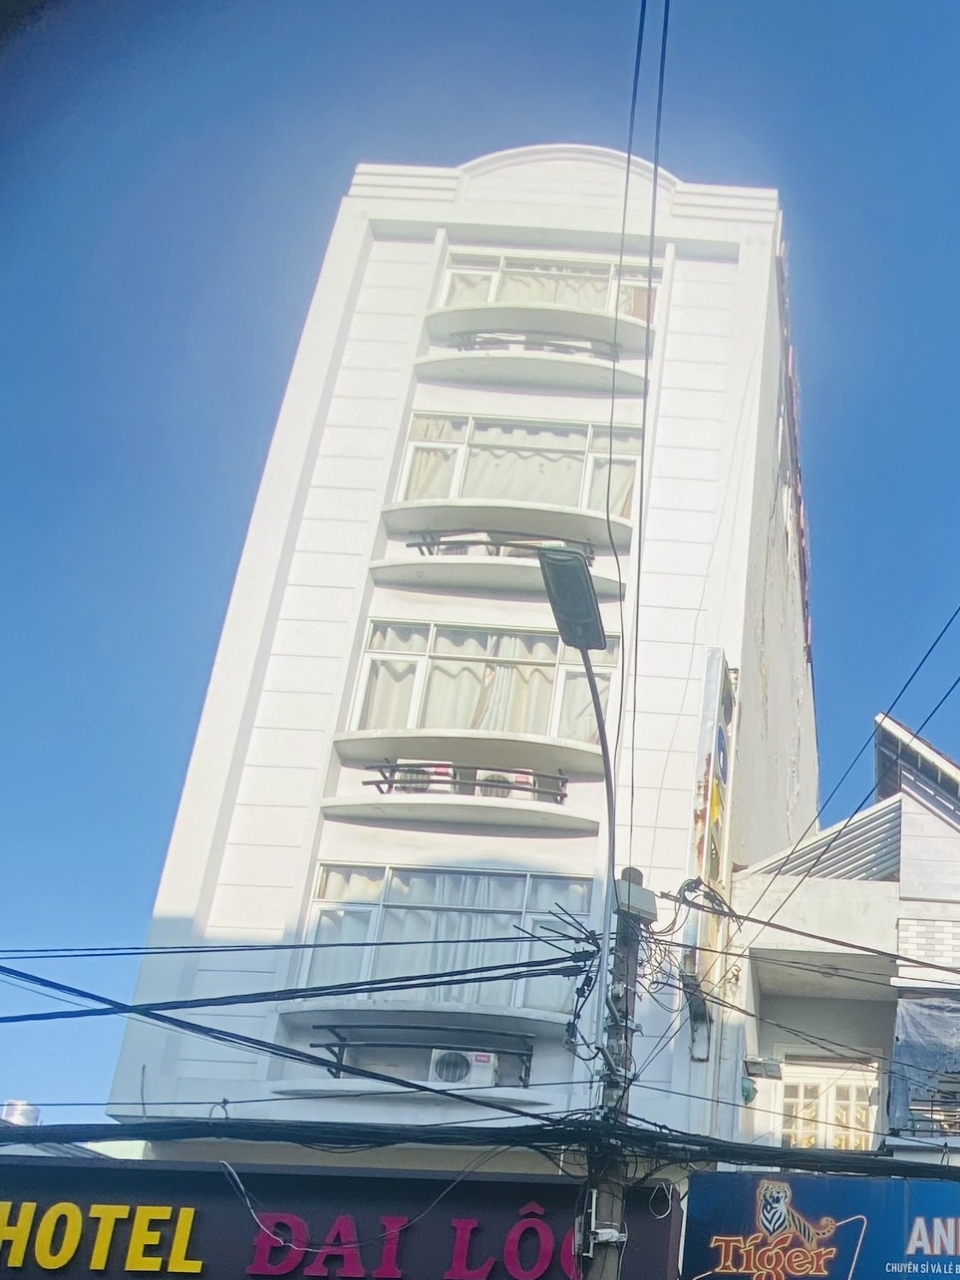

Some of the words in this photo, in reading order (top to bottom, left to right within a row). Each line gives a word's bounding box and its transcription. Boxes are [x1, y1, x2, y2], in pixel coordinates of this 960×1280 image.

[0, 1202, 204, 1273] HOTEL
[885, 1262, 918, 1274] CHUYÊN
[931, 1262, 942, 1274] VÀ
